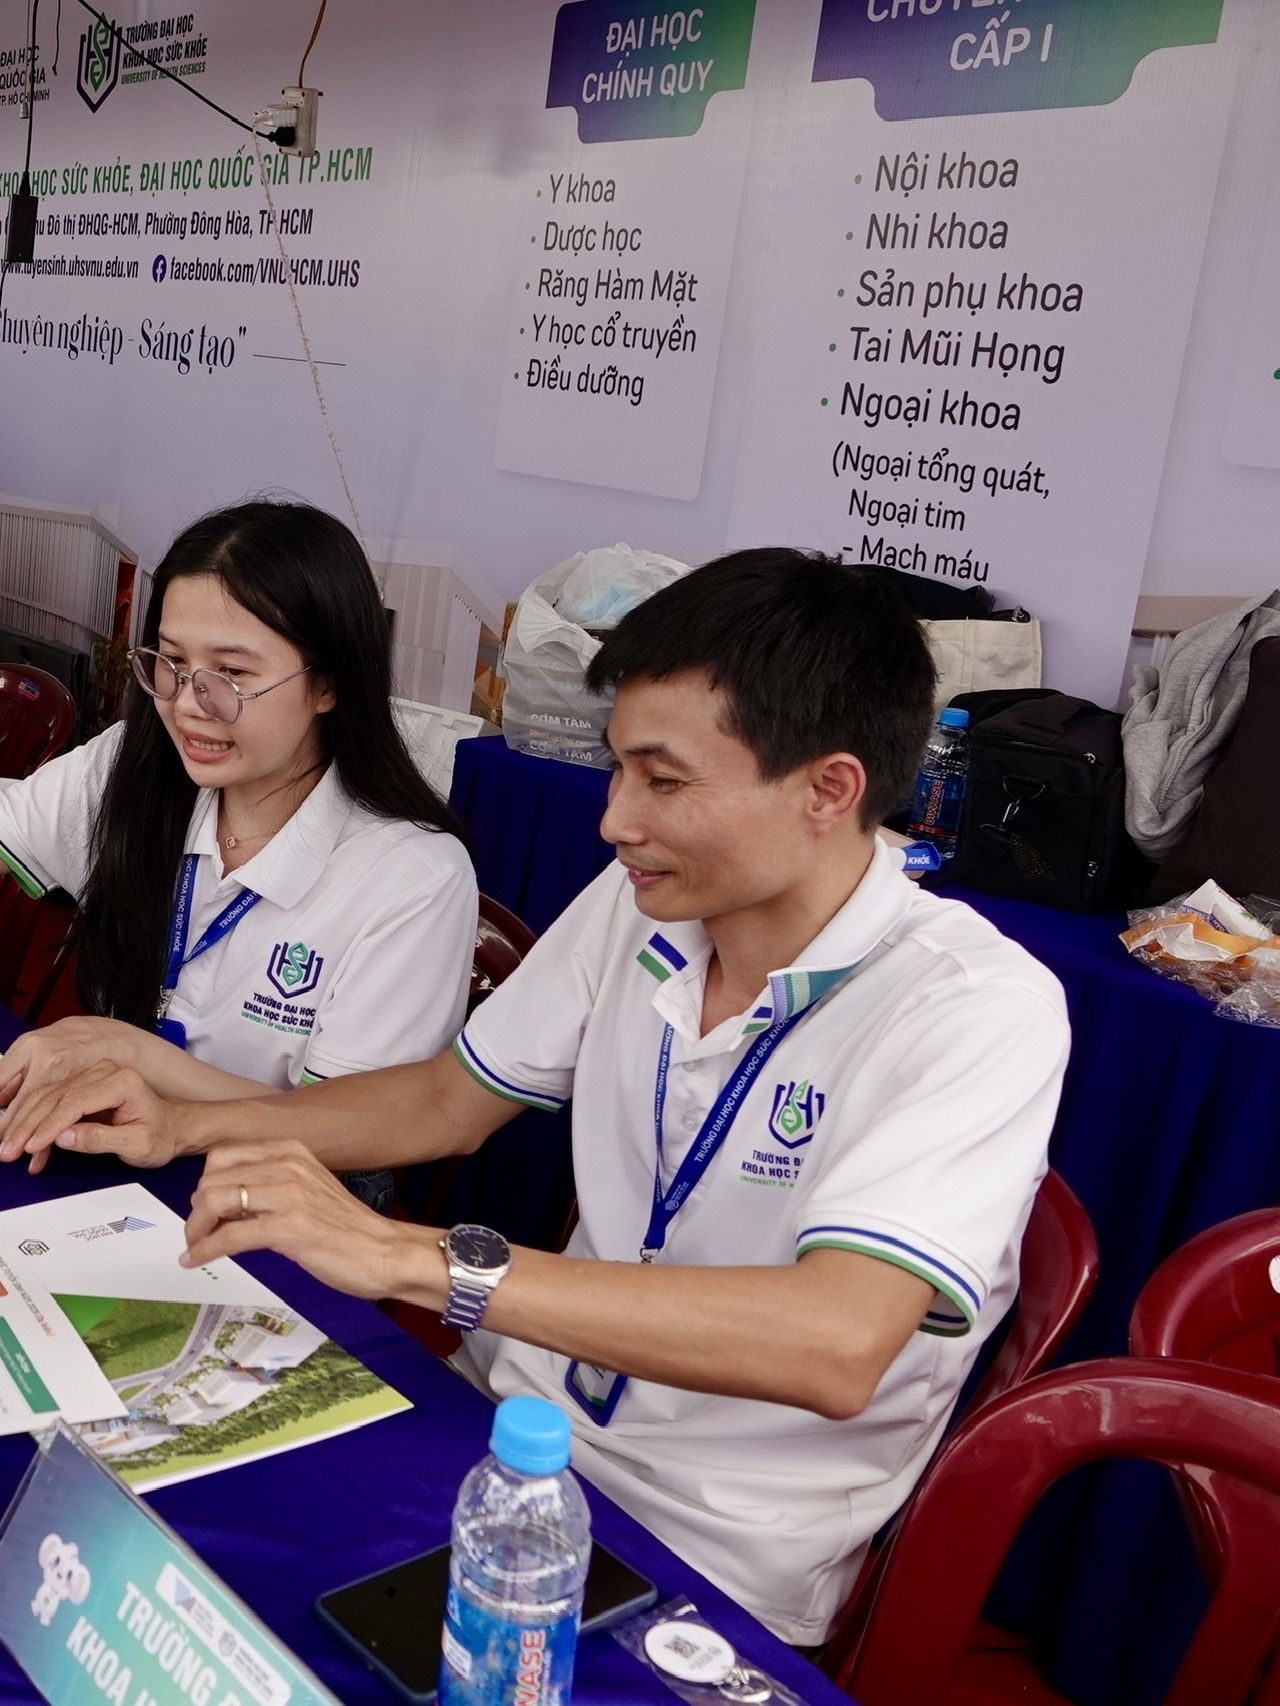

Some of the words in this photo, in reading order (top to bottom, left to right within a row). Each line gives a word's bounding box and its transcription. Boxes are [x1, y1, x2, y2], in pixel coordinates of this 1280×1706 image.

[126, 20, 158, 44] TRƯỜNG
[160, 18, 175, 40] ĐẠI
[176, 14, 194, 38] HỌC
[606, 18, 645, 57] ĐẠI
[650, 8, 704, 51] HỌC
[950, 10, 1031, 71] CẤP
[1040, 23, 1053, 62] I
[0, 50, 16, 69] ĐẠI
[18, 45, 40, 66] HỌC
[123, 50, 145, 69] KHOA
[165, 40, 183, 62] SỨC
[184, 33, 208, 59] KHỎE
[582, 60, 654, 104] CHÍNH
[660, 59, 714, 97] QUY
[32, 169, 57, 201] HỌC
[62, 161, 88, 195] SỨC
[93, 156, 134, 197] KHỎE,
[140, 162, 165, 197] ĐẠI
[170, 159, 202, 196] HỌC
[208, 145, 254, 190] QUỐC
[550, 172, 564, 204] Y
[566, 172, 616, 204] khoa
[875, 151, 930, 199] Nội
[937, 151, 1020, 190] khoa
[47, 214, 61, 235] Đô
[63, 214, 76, 240] thị
[78, 212, 141, 238] ĐHQG-HCM,
[145, 211, 187, 240] Phường
[190, 211, 221, 240] Đông
[225, 210, 253, 240] Hòa,
[544, 221, 597, 257] Dược
[602, 220, 643, 257] học
[866, 213, 920, 250] Nhi
[927, 212, 1009, 250] khoa
[538, 268, 589, 307] Răng
[594, 267, 645, 300] Hàm
[651, 269, 699, 308] Mặt
[856, 267, 914, 308] Sản
[922, 271, 986, 318] phụ
[996, 271, 1084, 313] khoa
[58, 313, 123, 366] nghiệp
[139, 317, 195, 376] Sáng
[198, 324, 248, 375] tạo"
[533, 313, 547, 343] Y
[549, 315, 586, 350] học
[591, 311, 622, 348] cổ
[622, 314, 697, 359] truyền
[850, 326, 893, 363] Tai
[900, 328, 962, 369] Mũi
[970, 331, 1066, 384] Họng
[526, 354, 572, 391] Điều
[577, 363, 645, 406] dưỡng
[840, 381, 932, 428] Ngoại
[940, 389, 1022, 431] khoa
[832, 440, 912, 482] (Ngoại
[918, 447, 976, 493] tổng
[982, 461, 1050, 500] quát,
[848, 488, 919, 529] Ngoại
[924, 500, 966, 531] tim
[933, 548, 989, 583] máu
[924, 779, 943, 825] BIWASE
[907, 853, 930, 865] KHỎE
[219, 905, 244, 929] TRƯỜNG
[241, 1010, 268, 1025] UNIVERSITY
[243, 1001, 262, 1015] KHOA
[264, 1009, 280, 1021] HỌC
[253, 992, 282, 1010] TRƯỜNG
[284, 1004, 298, 1014] ĐẠI
[300, 1007, 316, 1017] HỌC
[694, 1130, 717, 1162] TRƯỜNG
[713, 1116, 726, 1132] ĐẠI
[720, 1098, 735, 1117] HỌC
[731, 1076, 749, 1099] KHOA
[744, 1056, 760, 1077] HỌC
[755, 1038, 771, 1057] SỨC
[741, 1161, 765, 1175] KHOA
[769, 1167, 791, 1179] HỌC
[752, 1150, 790, 1165] TRƯỜNG
[65, 1615, 132, 1706] KHOA
[116, 1580, 217, 1706] TRƯỜNG
